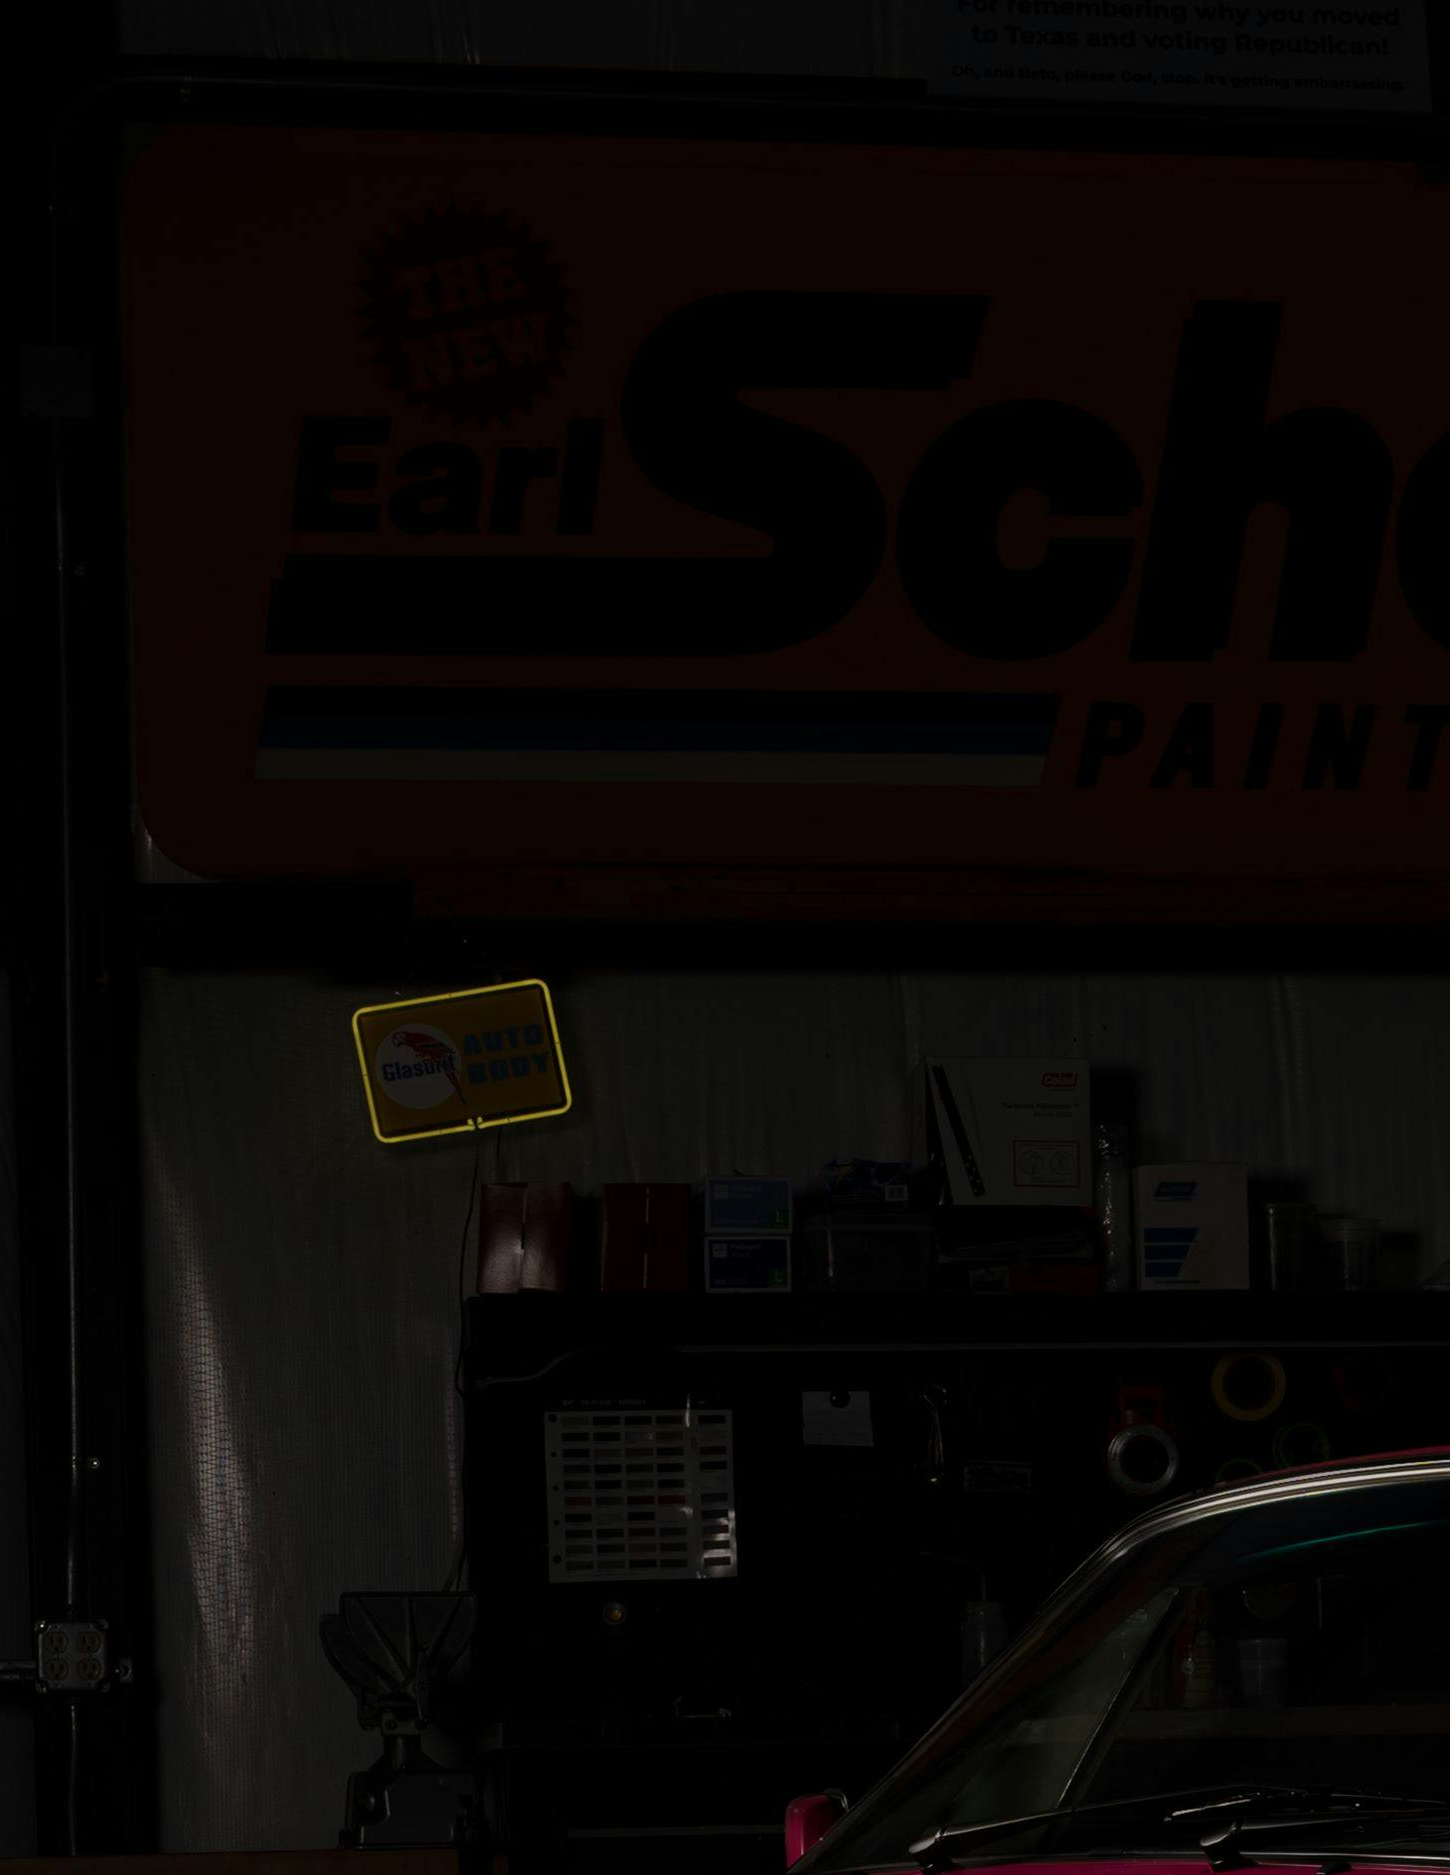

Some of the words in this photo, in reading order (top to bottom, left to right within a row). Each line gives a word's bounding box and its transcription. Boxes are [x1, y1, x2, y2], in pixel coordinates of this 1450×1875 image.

[971, 25, 998, 44] to
[1006, 25, 1080, 47] Texas
[1086, 27, 1136, 49] and
[1144, 30, 1227, 55] voting
[1235, 32, 1390, 60] Republican!
[1000, 0, 1188, 24] remembering
[1196, 4, 1249, 27] why
[1256, 6, 1304, 27] you
[1311, 6, 1402, 27] moved
[392, 252, 525, 322] THE
[400, 312, 550, 394] NEW
[292, 415, 604, 538] Earl
